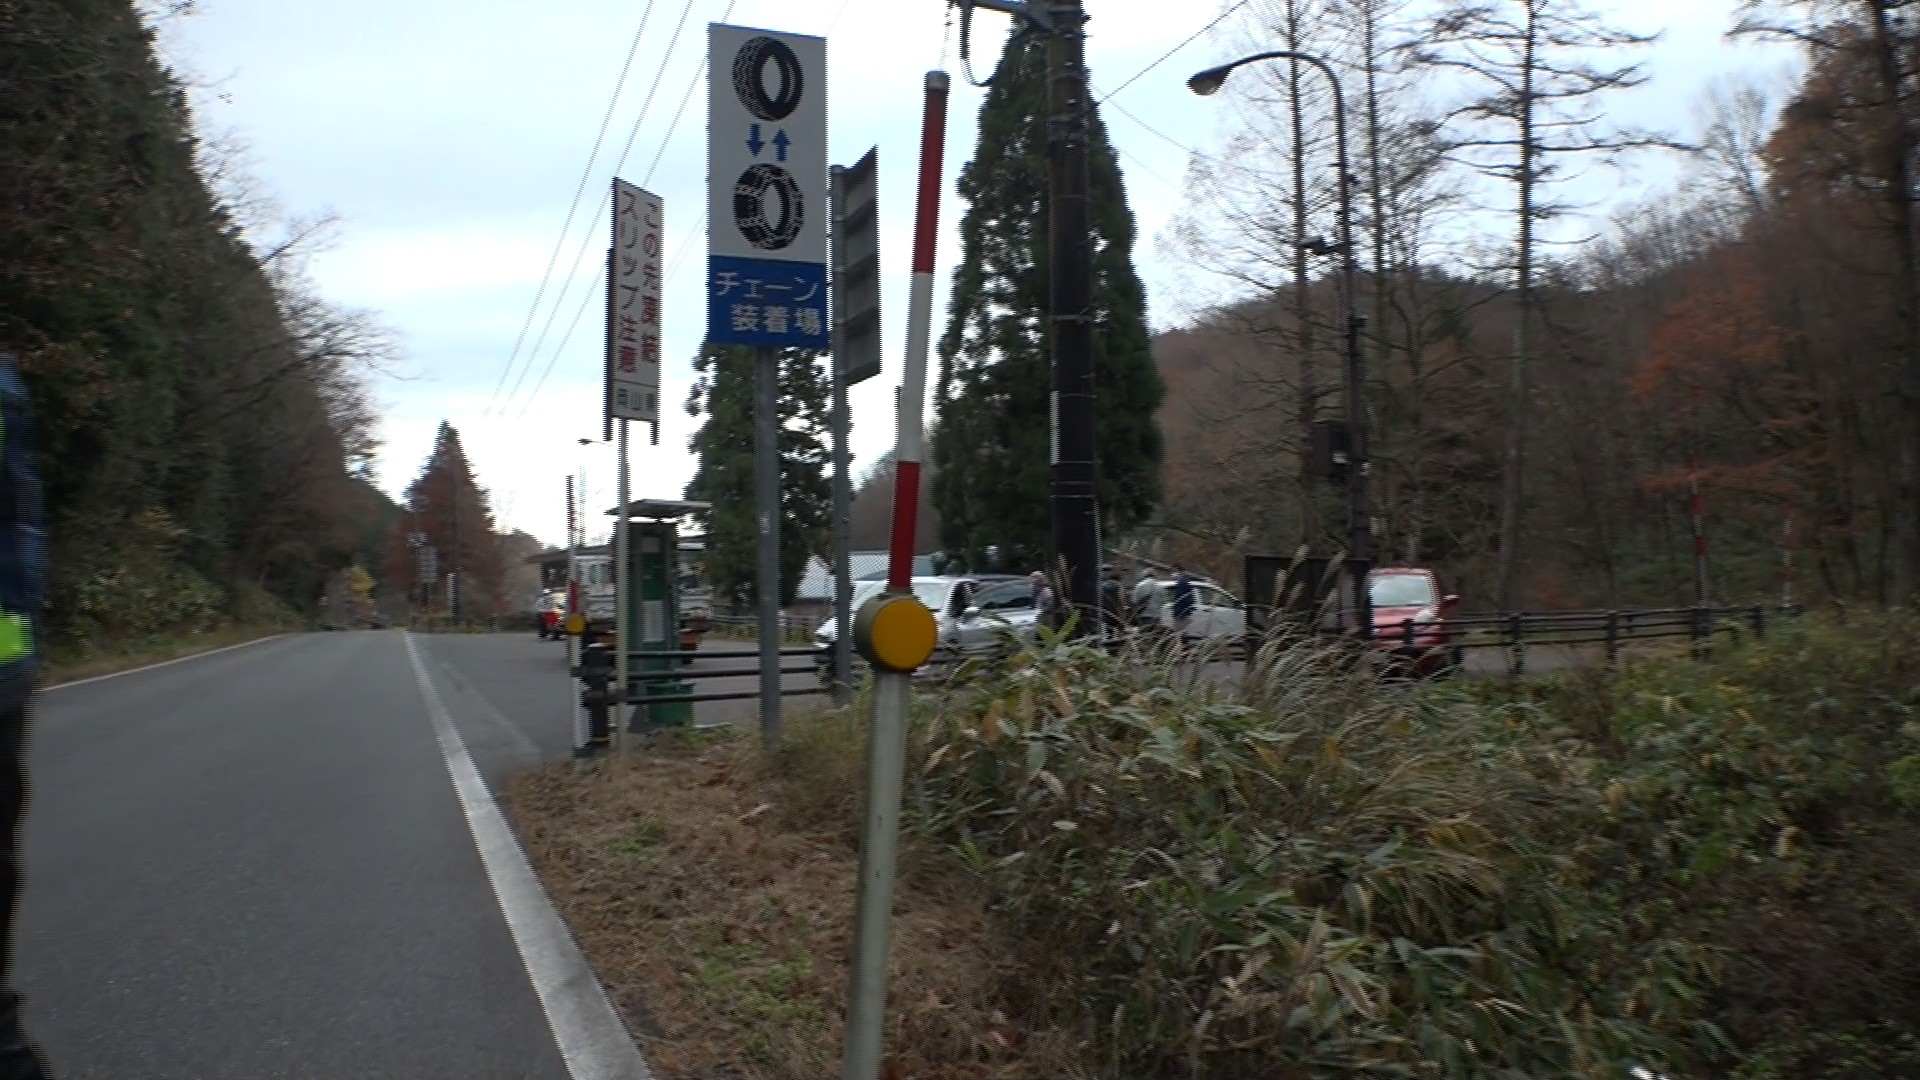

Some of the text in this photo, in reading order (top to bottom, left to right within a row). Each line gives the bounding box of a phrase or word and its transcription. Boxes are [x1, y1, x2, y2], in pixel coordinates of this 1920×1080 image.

[617, 189, 640, 375] スリップ注意
[713, 272, 819, 302] チェーン
[731, 304, 822, 336] 装着場
